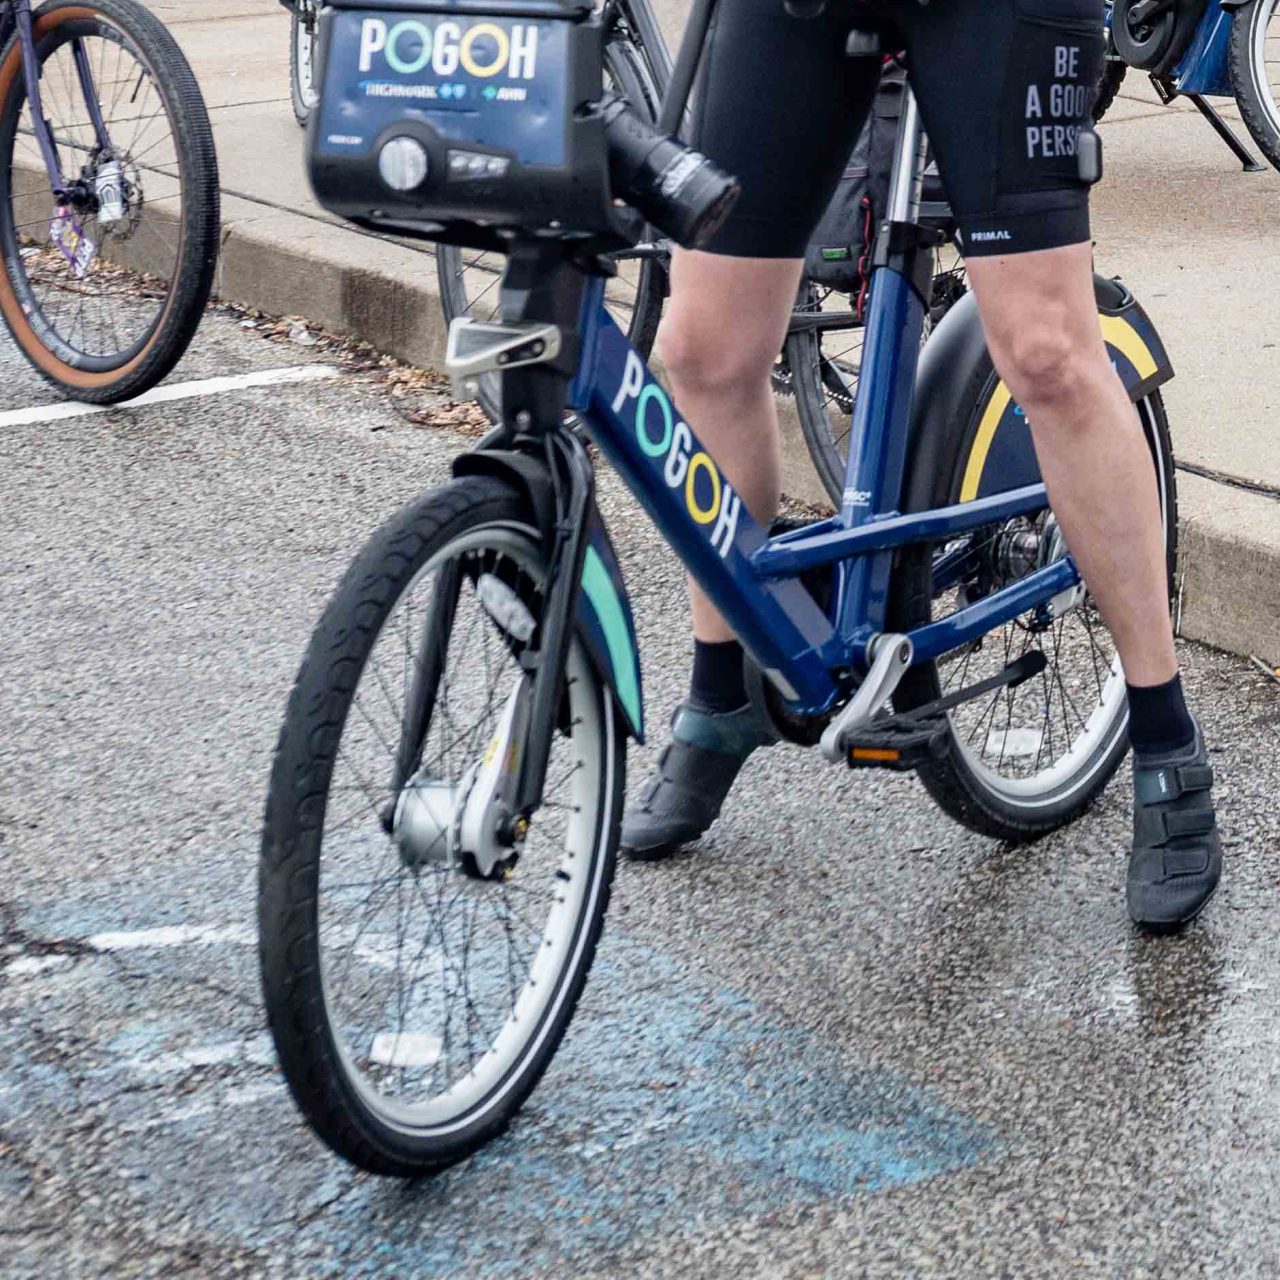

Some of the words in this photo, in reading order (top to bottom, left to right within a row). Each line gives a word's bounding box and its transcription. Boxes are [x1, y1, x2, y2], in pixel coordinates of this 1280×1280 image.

[358, 18, 539, 80] POGOH
[1054, 45, 1080, 78] BE
[1024, 84, 1043, 119] A
[1026, 124, 1081, 158] PERS
[970, 230, 1012, 242] PRIMAL
[611, 349, 742, 559] POGOH
